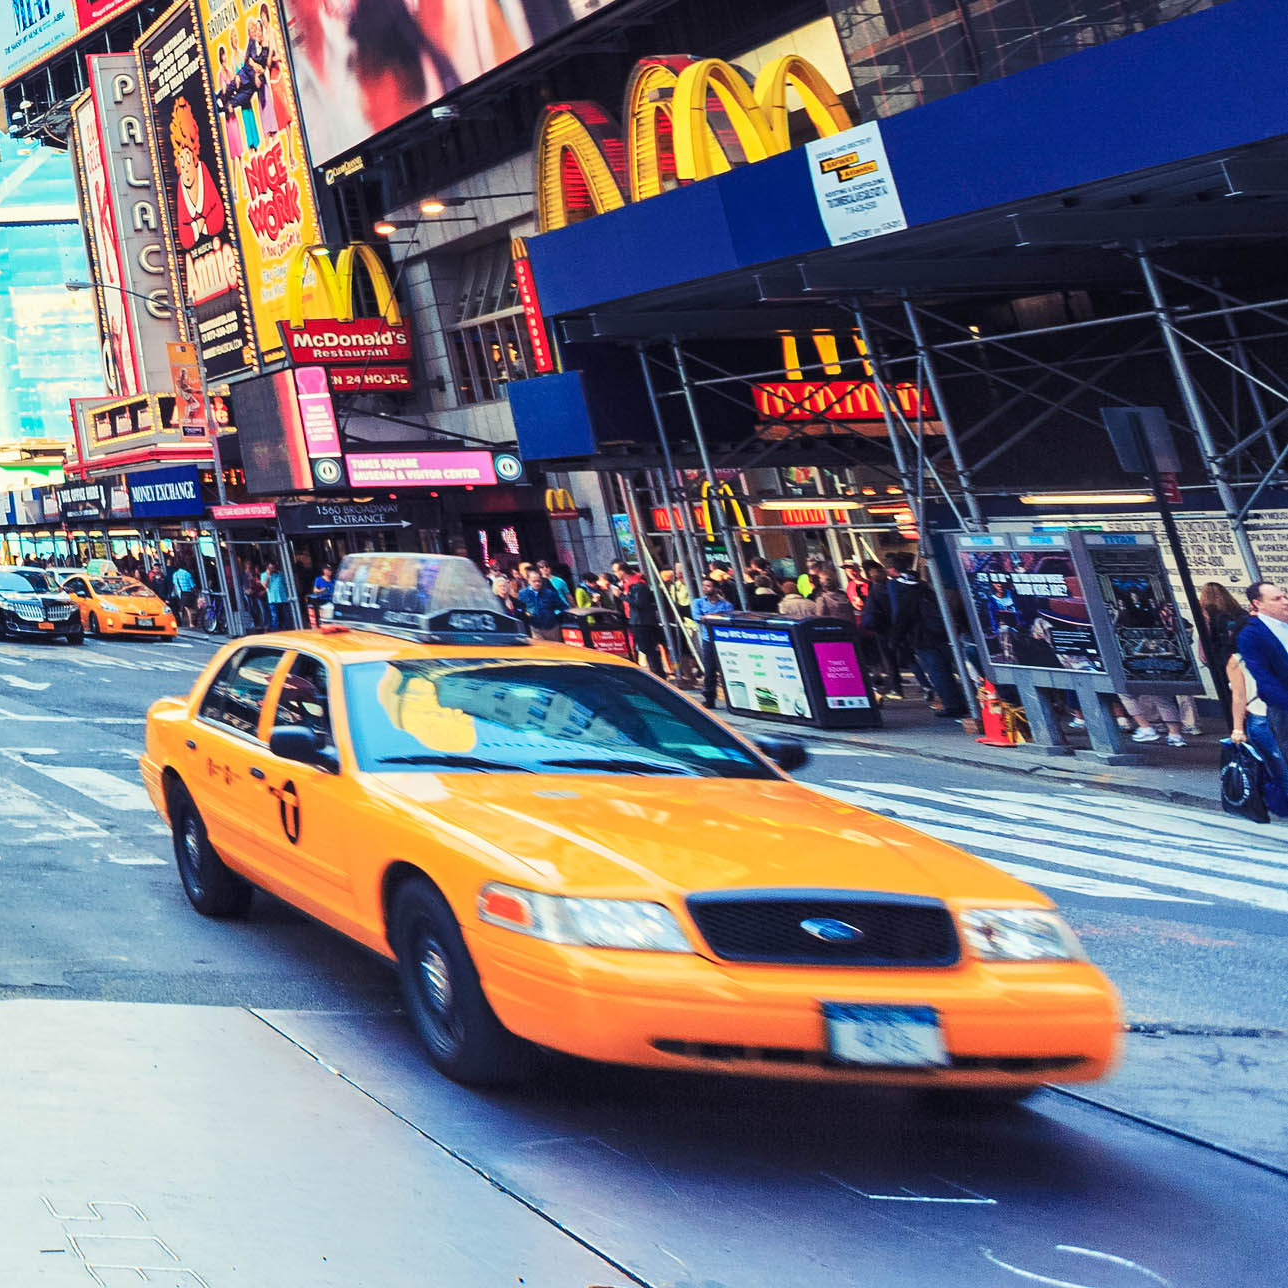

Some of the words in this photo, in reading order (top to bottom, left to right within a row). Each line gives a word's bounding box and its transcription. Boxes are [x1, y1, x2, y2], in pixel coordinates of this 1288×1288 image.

[207, 1, 239, 41] BRODERICK
[245, 142, 288, 197] NICE
[112, 73, 172, 320] PALACE
[248, 182, 301, 240] WORK
[186, 239, 238, 304] Annie
[293, 331, 408, 349] McDonald's
[313, 347, 389, 357] Restaurant
[350, 459, 380, 469] TIMES
[381, 458, 418, 469] SQUARE
[352, 469, 395, 481] MUSEUM
[406, 470, 441, 480] VISITOR
[443, 469, 481, 480] CENTER
[131, 483, 155, 503] MONEY
[156, 481, 196, 502] EXCHANGE
[317, 505, 342, 515] 1560
[344, 504, 399, 514] BROADWAY
[333, 513, 385, 524] ENTRANCE
